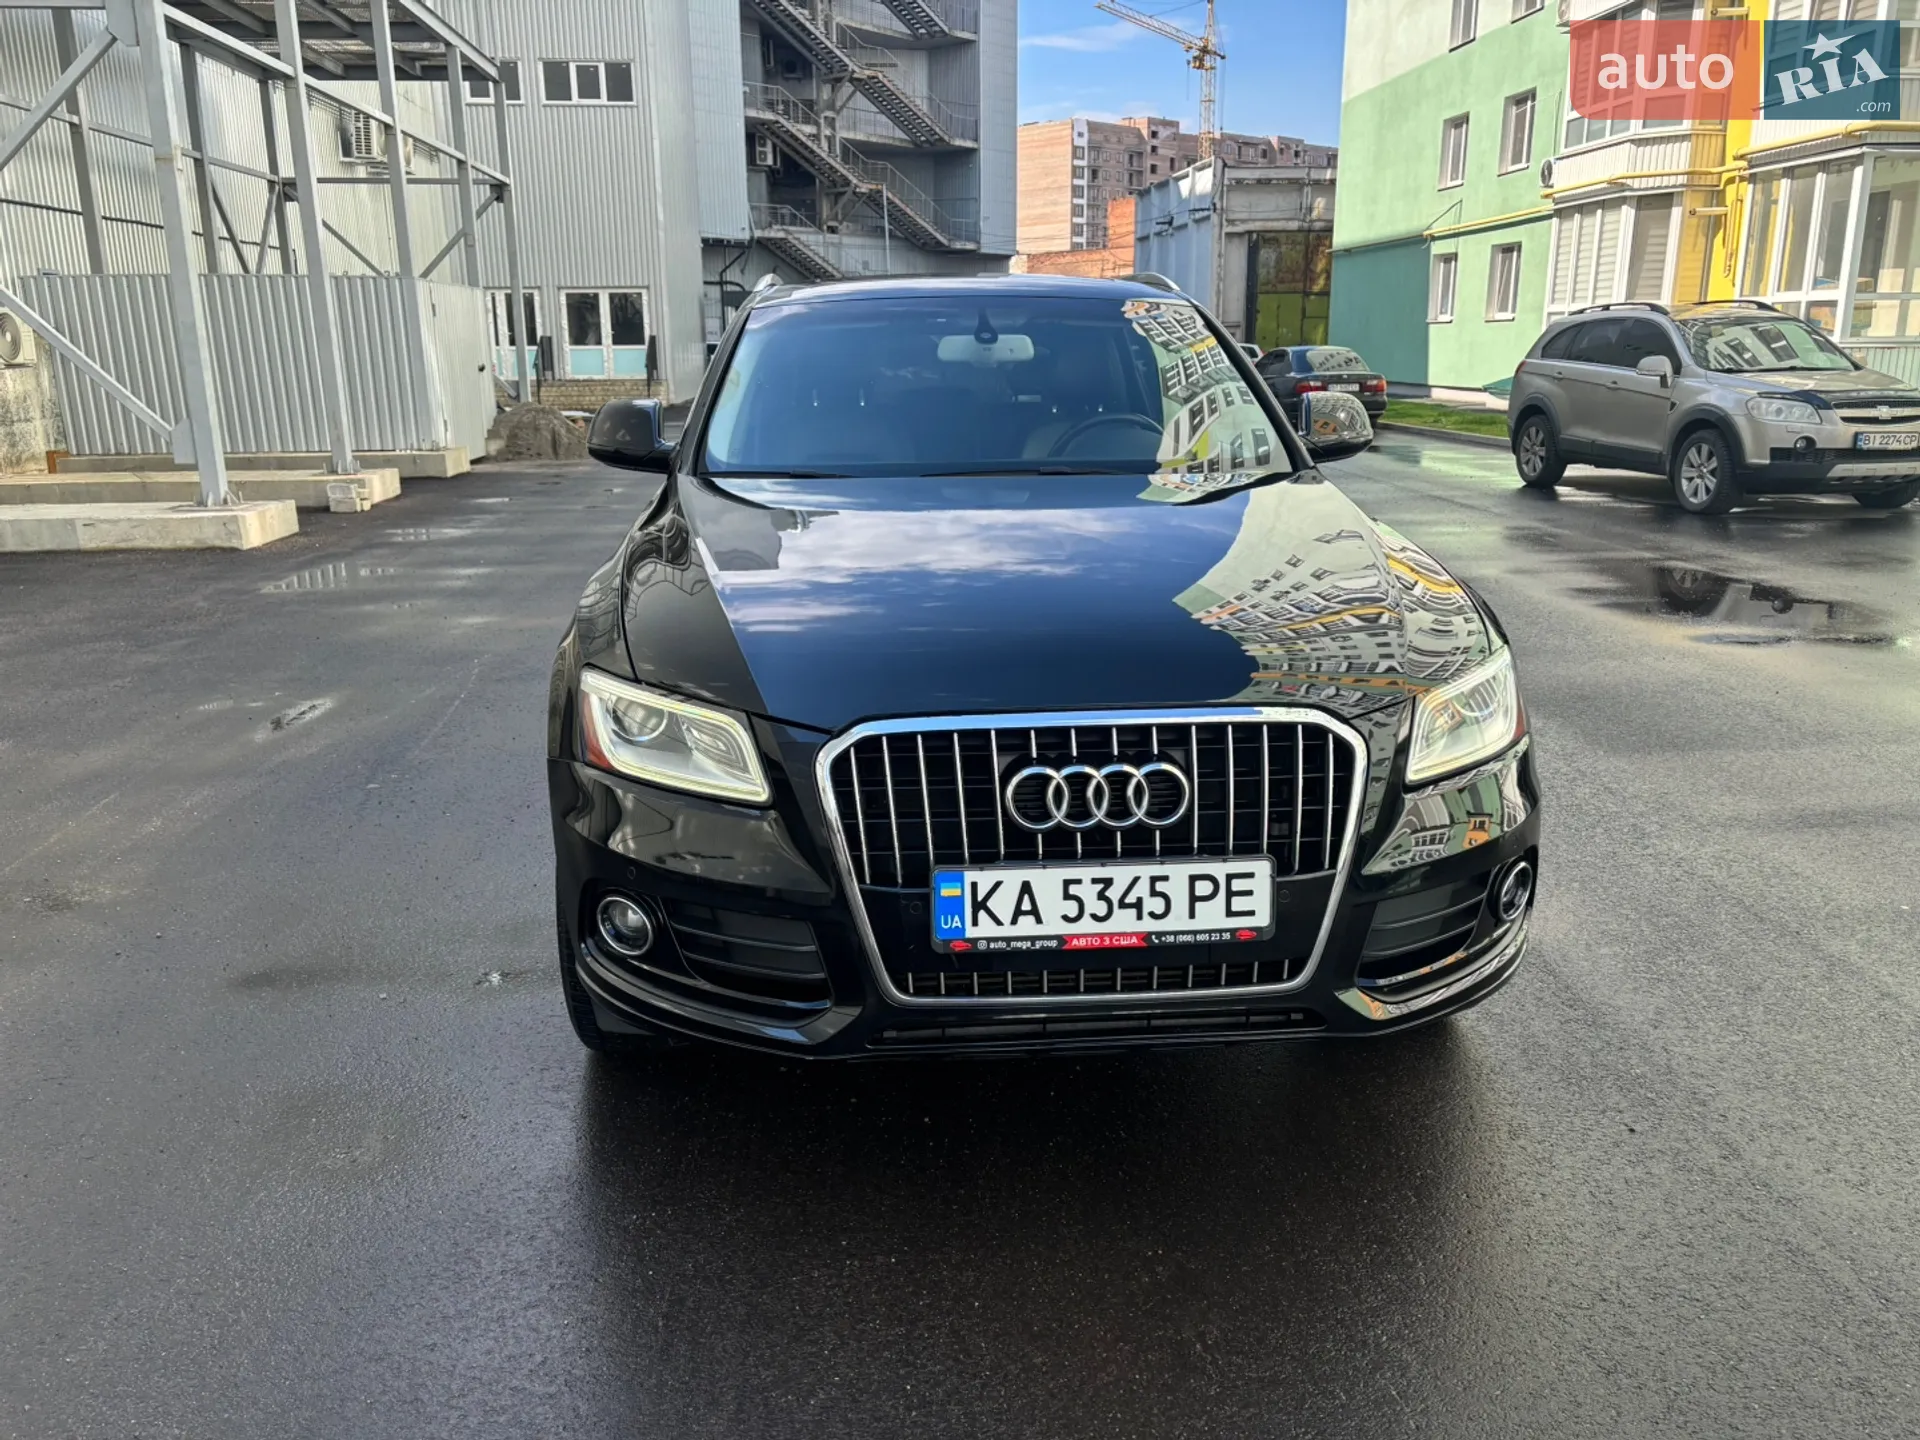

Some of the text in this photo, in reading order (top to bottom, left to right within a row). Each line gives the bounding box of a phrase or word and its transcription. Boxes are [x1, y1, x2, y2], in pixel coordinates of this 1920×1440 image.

[1863, 434, 1917, 446] BI 2274 CP
[970, 872, 1256, 928] KA 5345 PE
[941, 915, 963, 929] UA
[1071, 937, 1100, 947] АВТО
[1112, 935, 1138, 945] США
[1161, 934, 1175, 943] +38
[1211, 932, 1220, 940] 23
[1221, 931, 1231, 940] 35
[989, 938, 1058, 950] auto_mega_group
